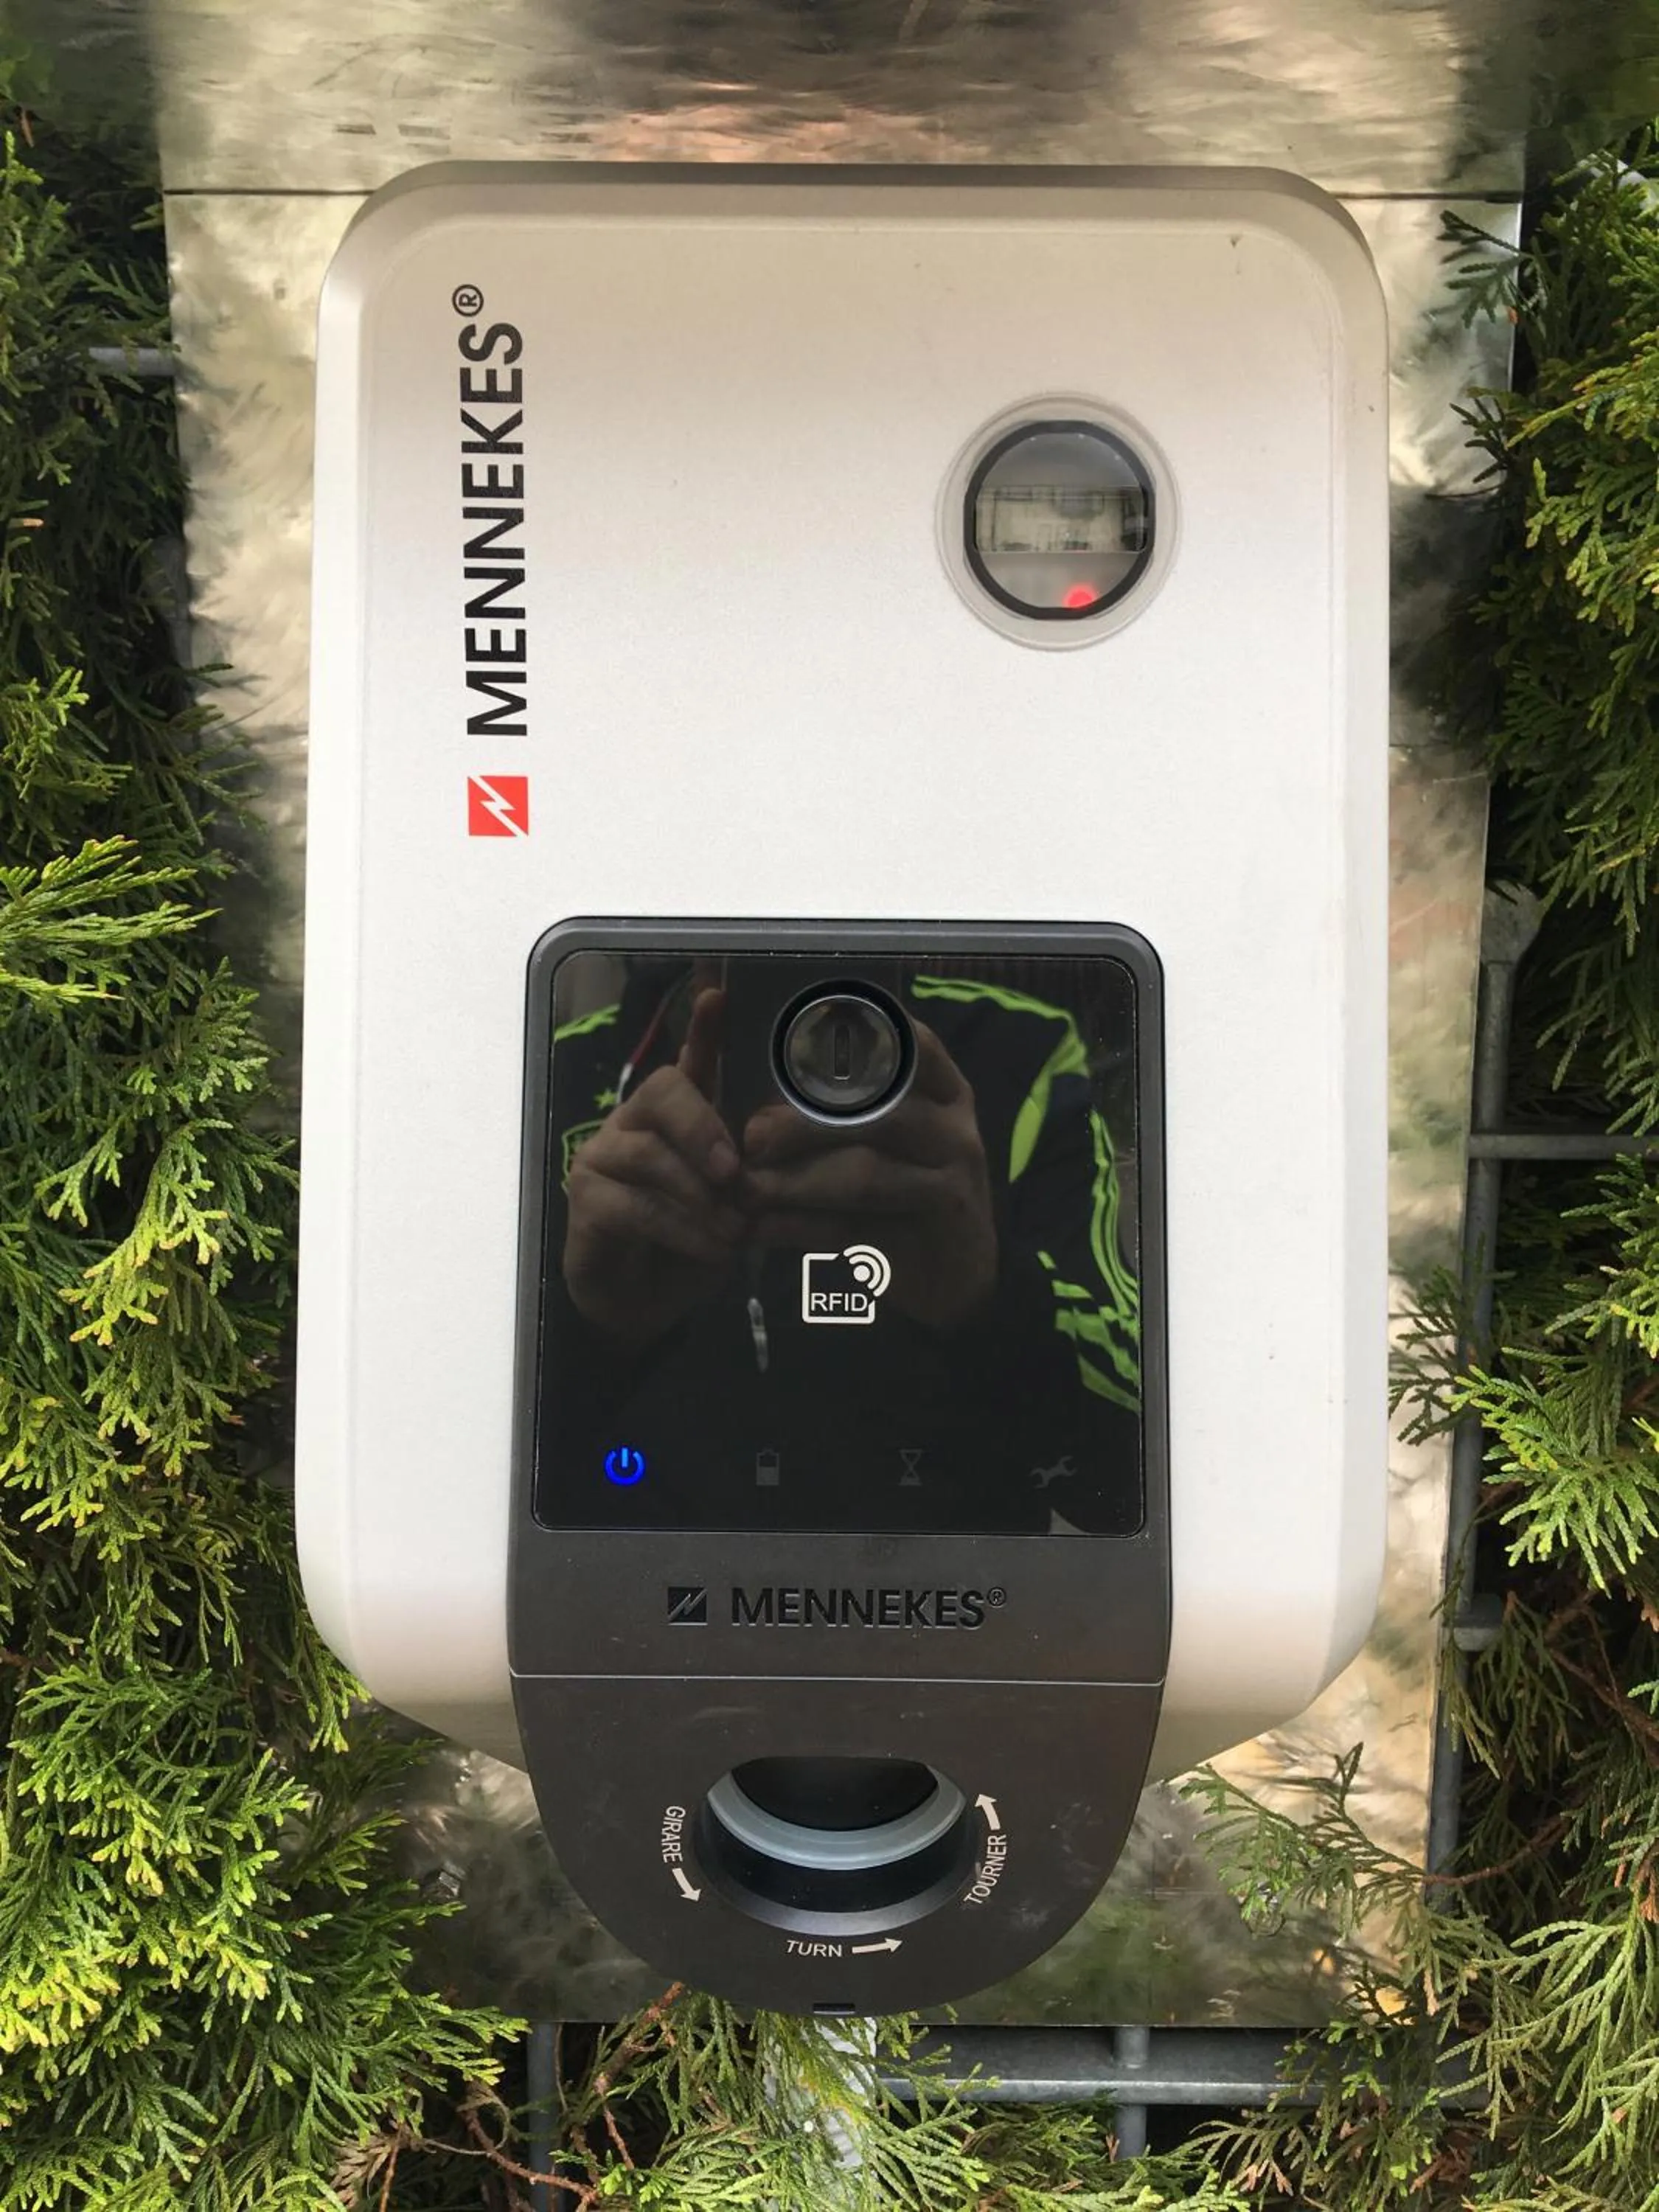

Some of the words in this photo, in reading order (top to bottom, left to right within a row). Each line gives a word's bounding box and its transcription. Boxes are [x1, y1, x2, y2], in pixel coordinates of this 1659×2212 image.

[811, 1293, 868, 1312] RFID
[661, 1806, 686, 1864] GIRARE
[964, 1834, 1007, 1906] TOURNER
[785, 1939, 843, 1958] TURN
